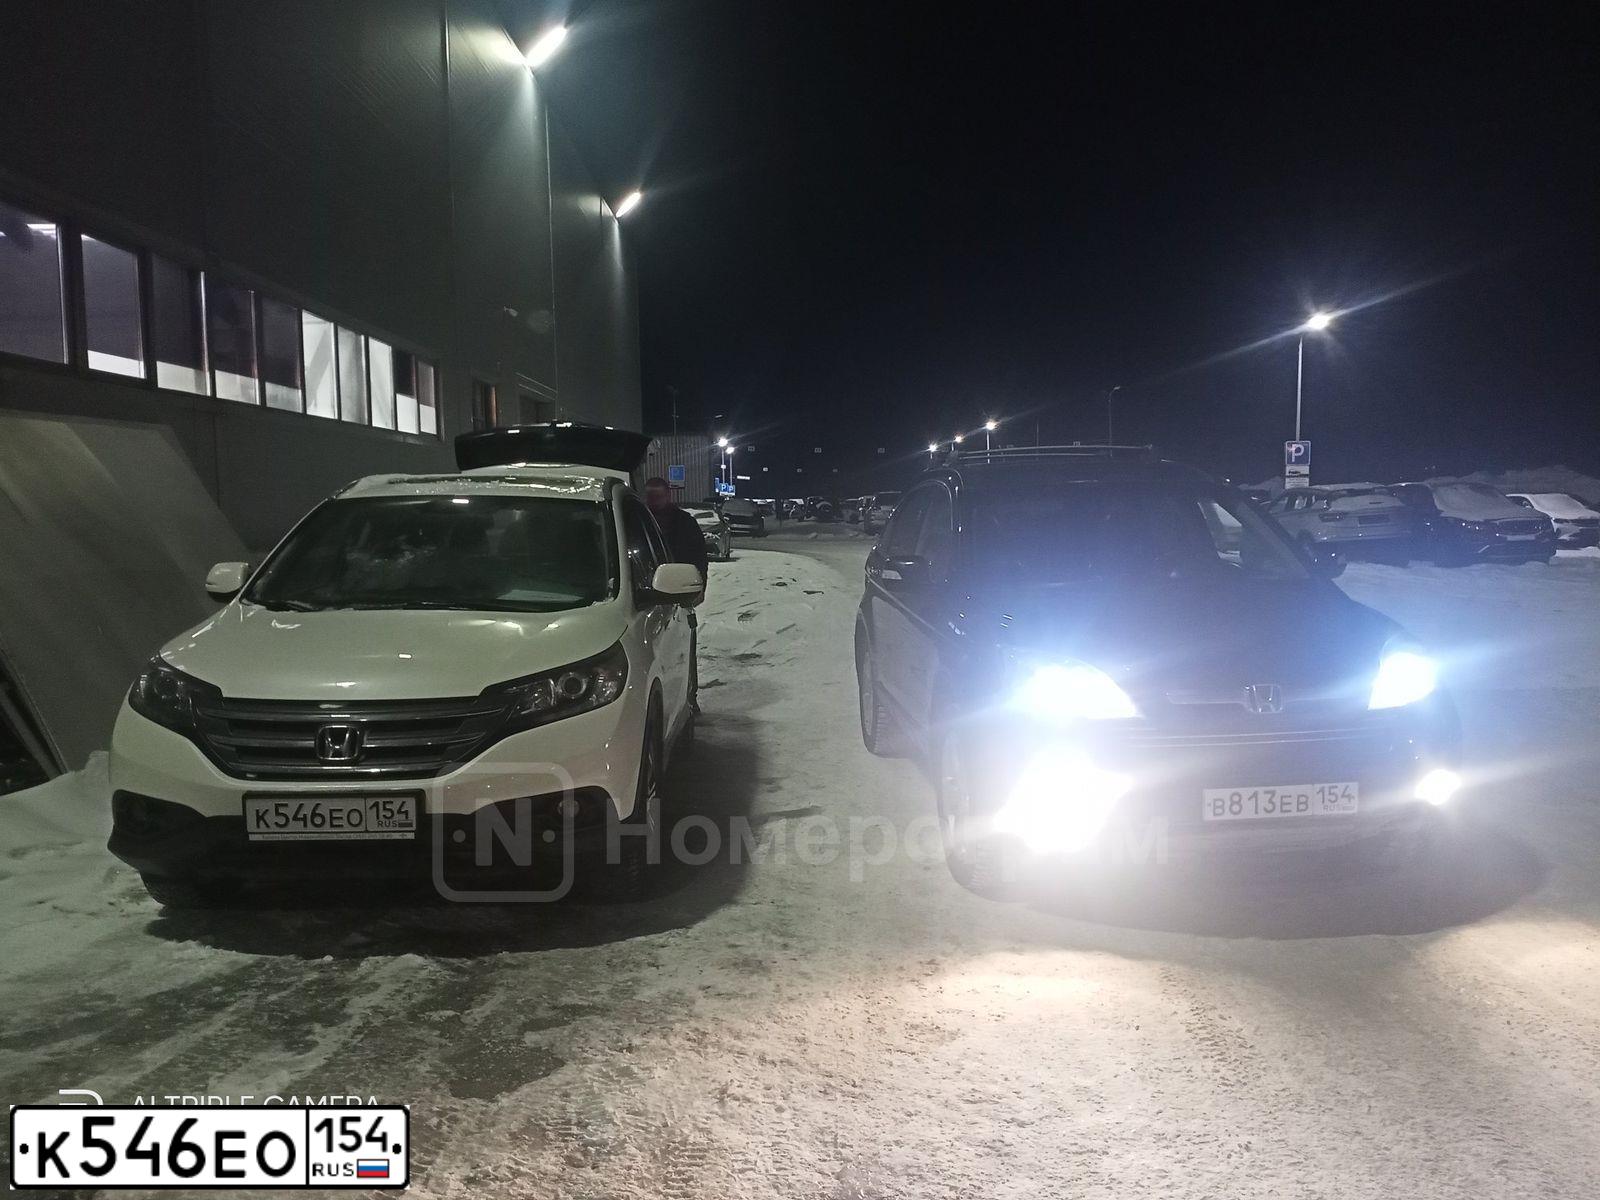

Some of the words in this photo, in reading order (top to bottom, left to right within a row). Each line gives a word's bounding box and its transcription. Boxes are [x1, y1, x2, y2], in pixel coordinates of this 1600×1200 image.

[1291, 443, 1305, 462] P
[255, 802, 364, 830] К546ЕО
[369, 801, 409, 820] 154
[1212, 790, 1309, 817] В813ЕВ
[1316, 785, 1352, 804] 154
